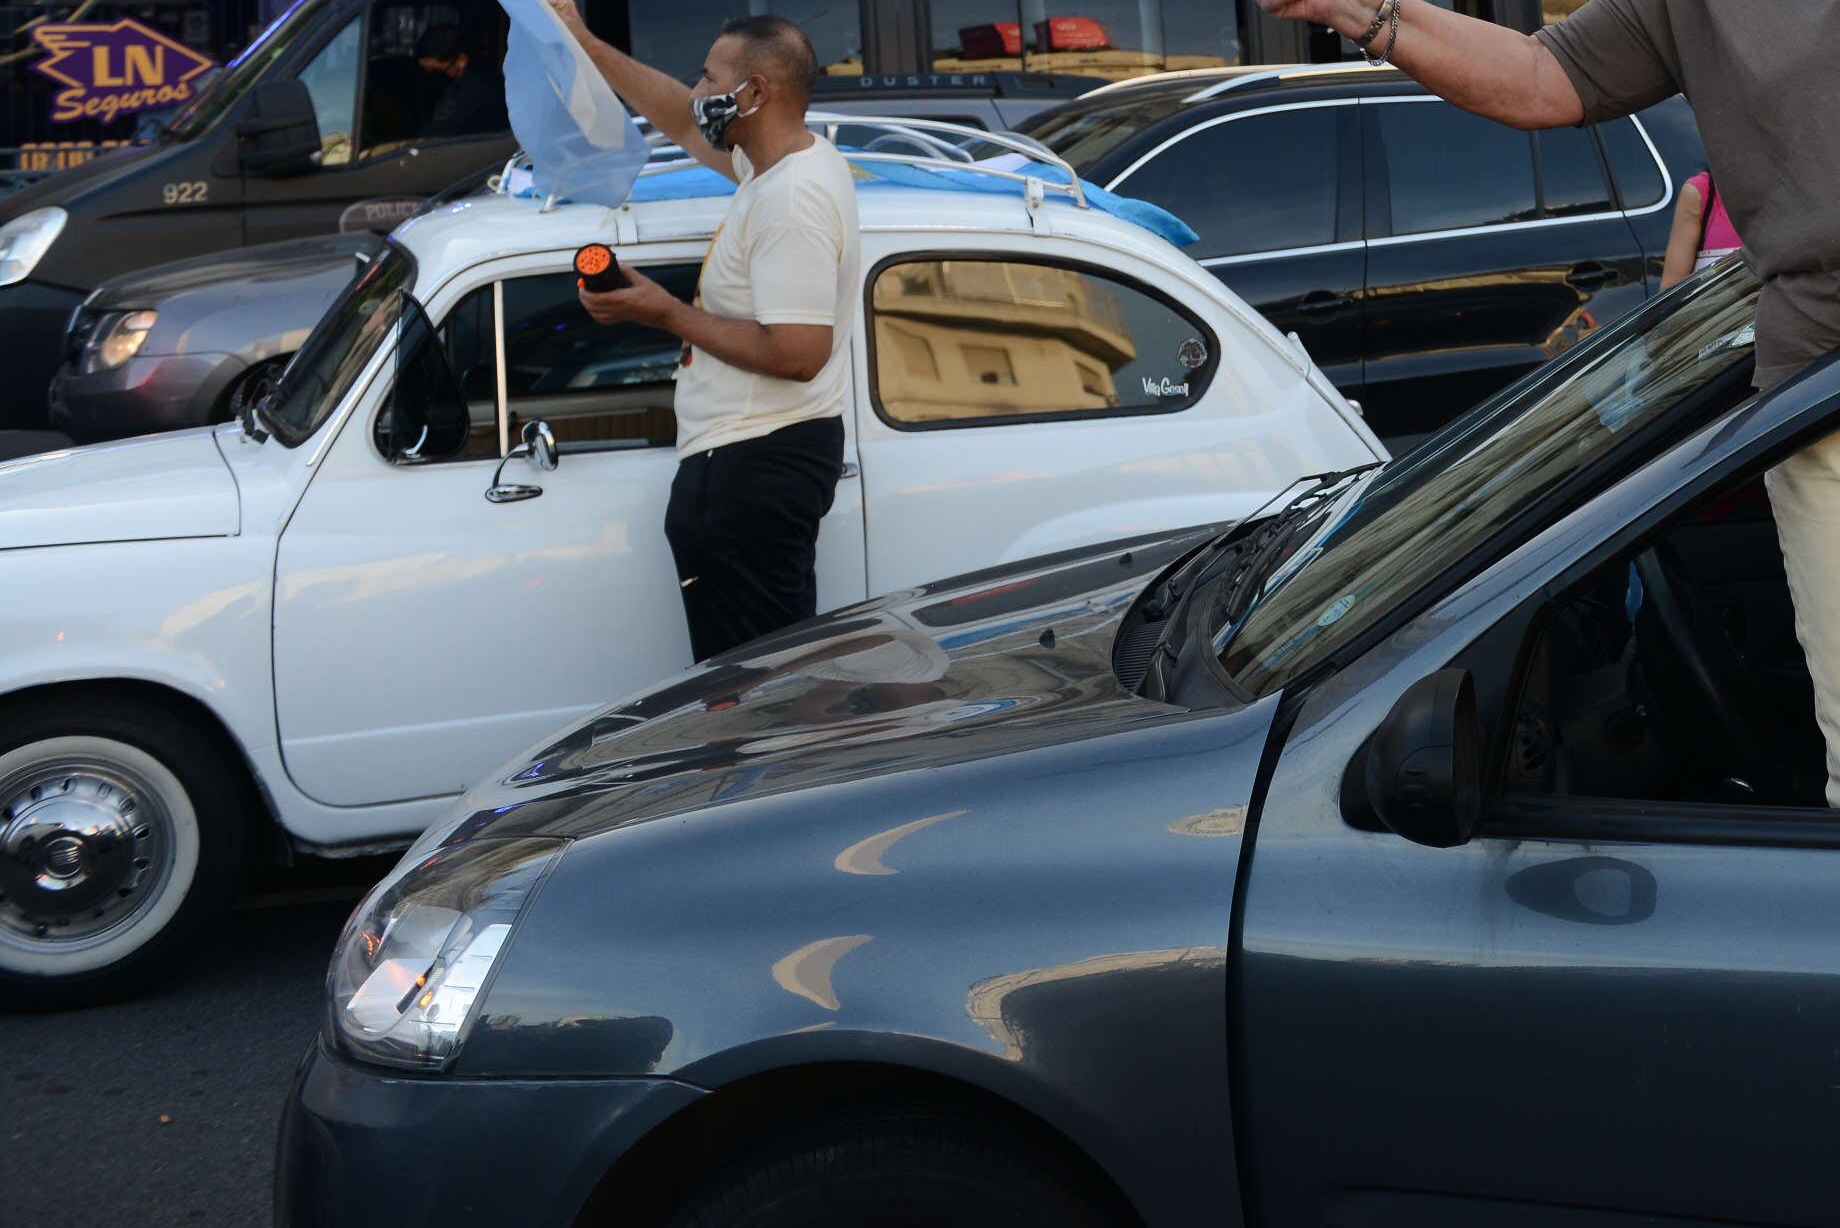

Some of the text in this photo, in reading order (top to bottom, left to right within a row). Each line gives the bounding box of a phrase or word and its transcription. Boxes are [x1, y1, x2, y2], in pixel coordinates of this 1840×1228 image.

[93, 44, 165, 87] LN
[860, 75, 986, 87] DUSTER
[53, 83, 191, 121] Seguros
[163, 181, 208, 204] 922
